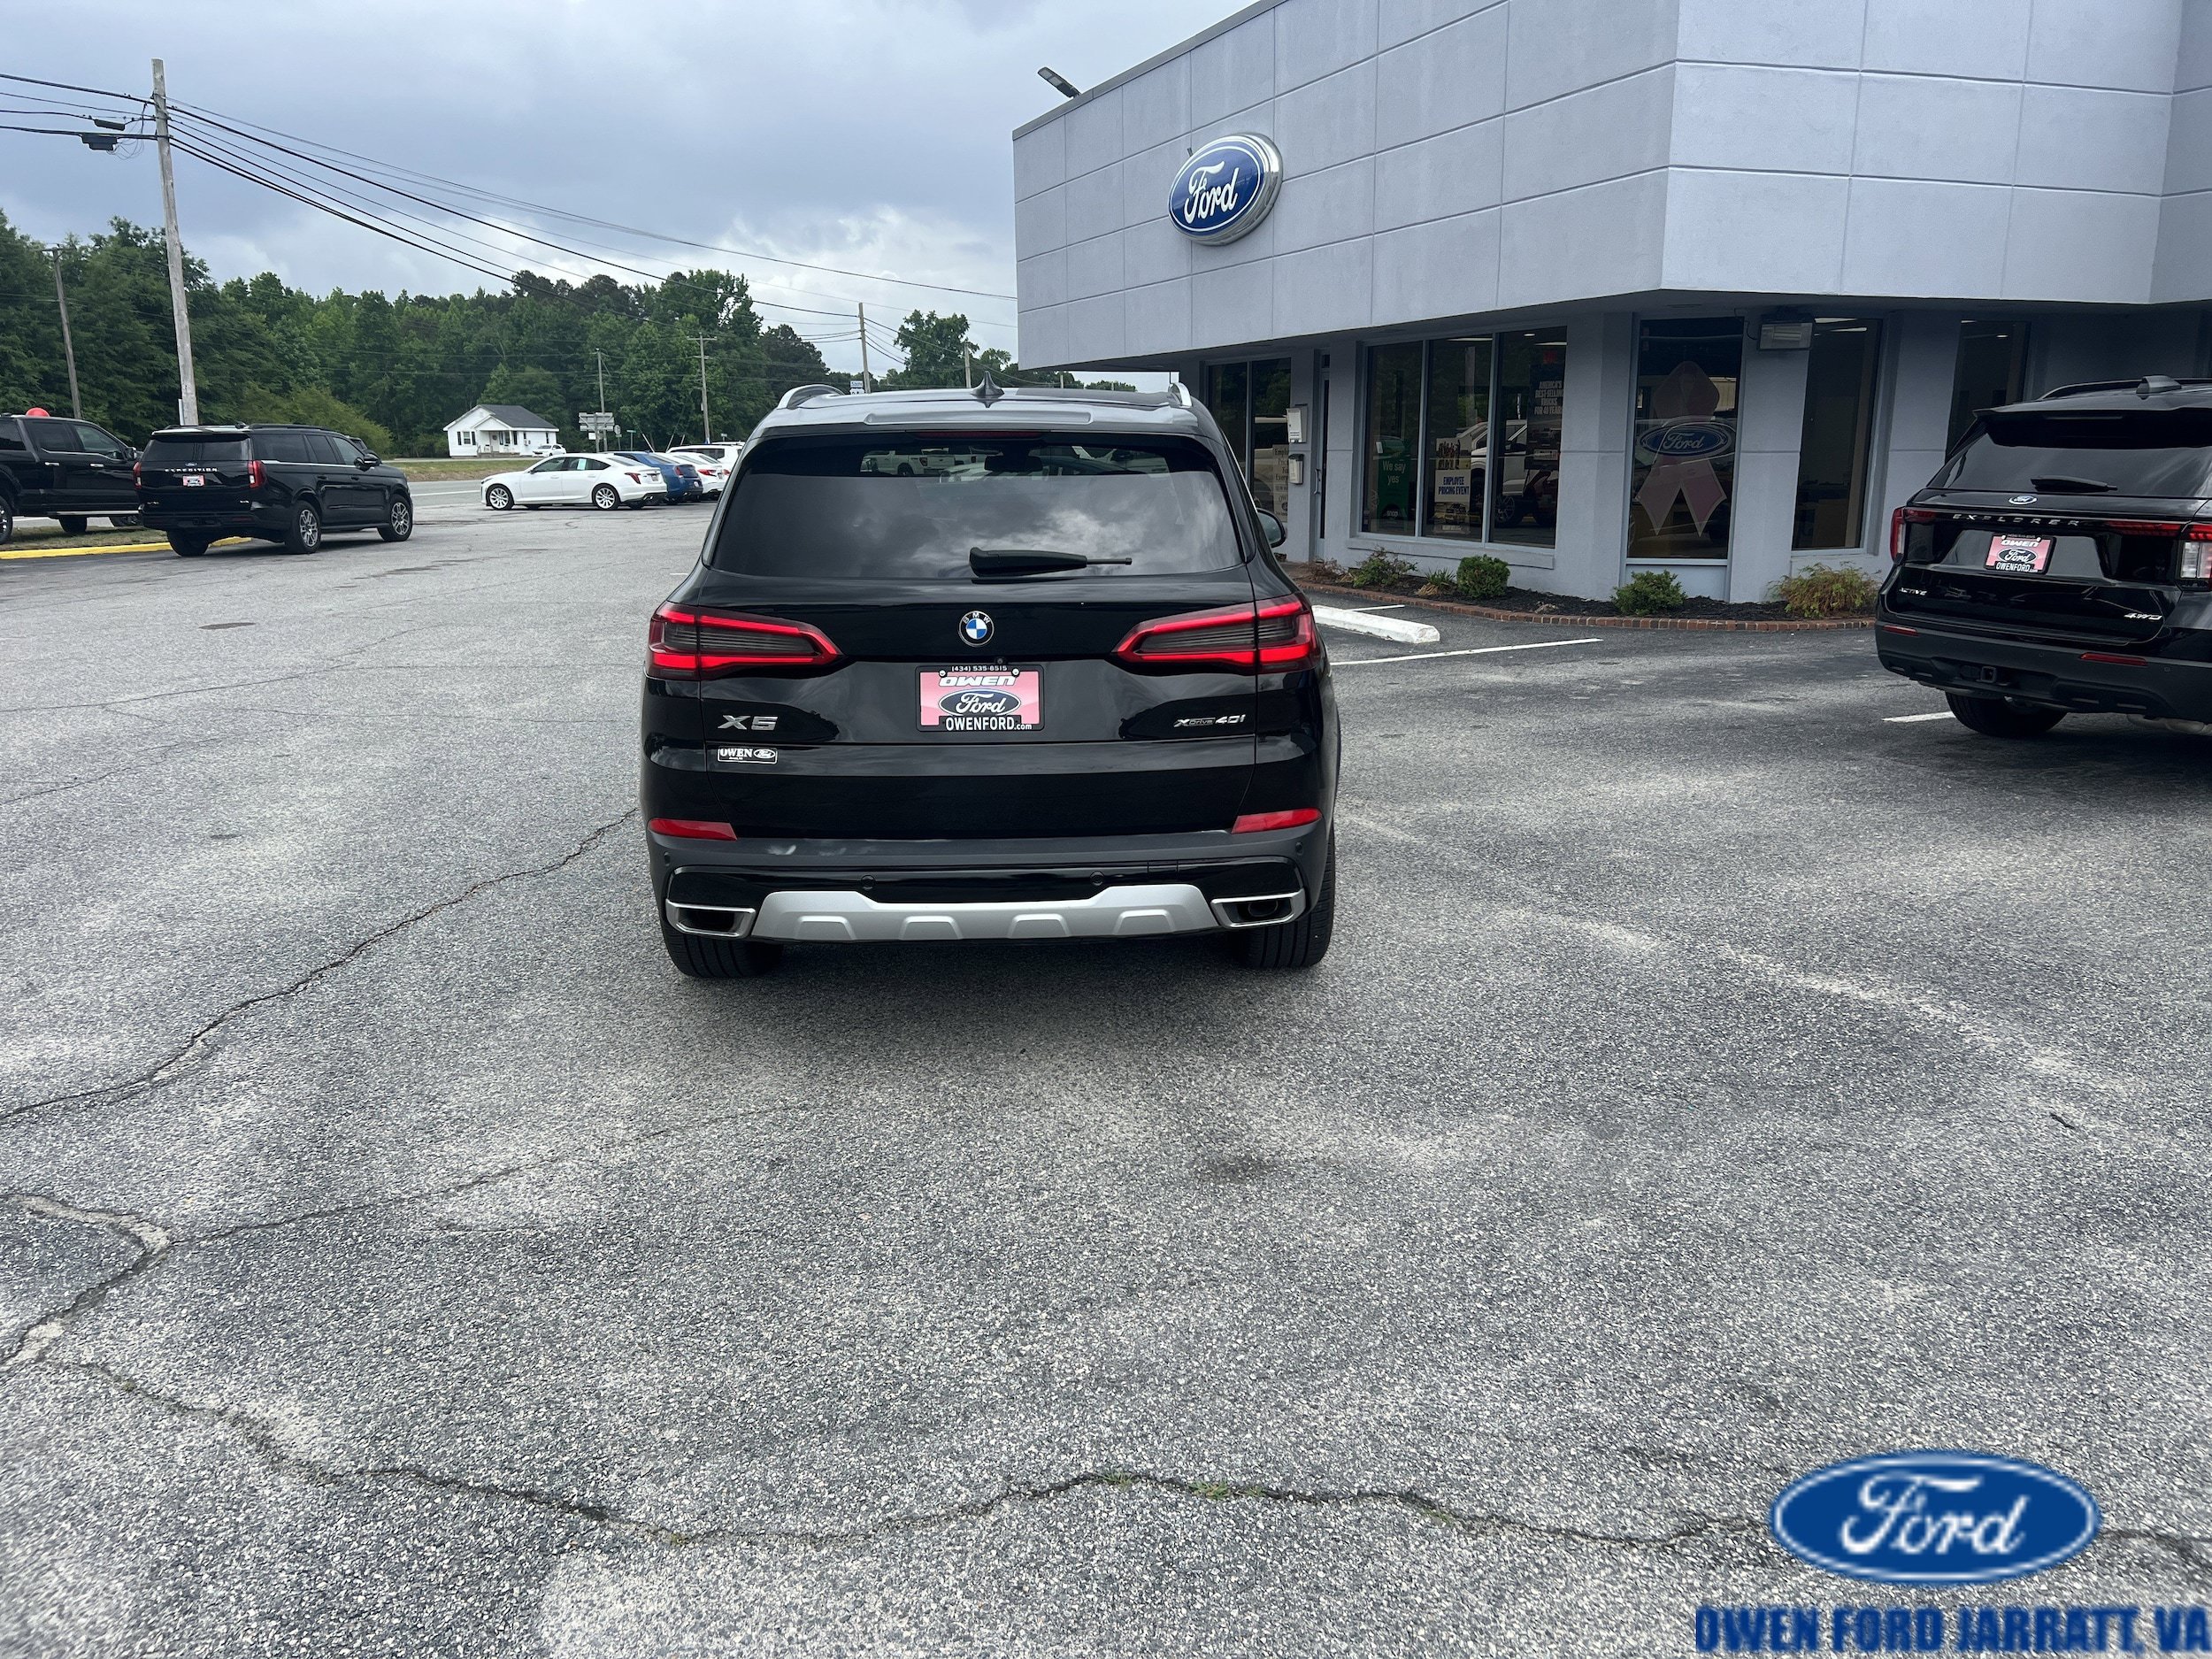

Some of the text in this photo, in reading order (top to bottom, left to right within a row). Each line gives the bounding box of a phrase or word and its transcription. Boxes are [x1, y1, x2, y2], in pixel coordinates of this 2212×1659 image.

[1184, 160, 1240, 224] Ford
[1663, 432, 1706, 449] Ford
[1382, 460, 1406, 473] We say
[1387, 475, 1400, 486] yes
[1443, 476, 1464, 485] EMPLOYEE
[1438, 486, 1470, 495] PRICING EVENT
[1952, 513, 2080, 526] EXPLORER
[2004, 549, 2032, 563] Ford
[1899, 587, 1928, 596] ACTIVE
[963, 611, 992, 624] BMW
[938, 675, 1017, 687] OWEN
[956, 692, 1007, 714] Ford
[718, 715, 779, 731] X5
[945, 716, 1033, 731] OWENFORD.com
[719, 748, 753, 758] OWEN
